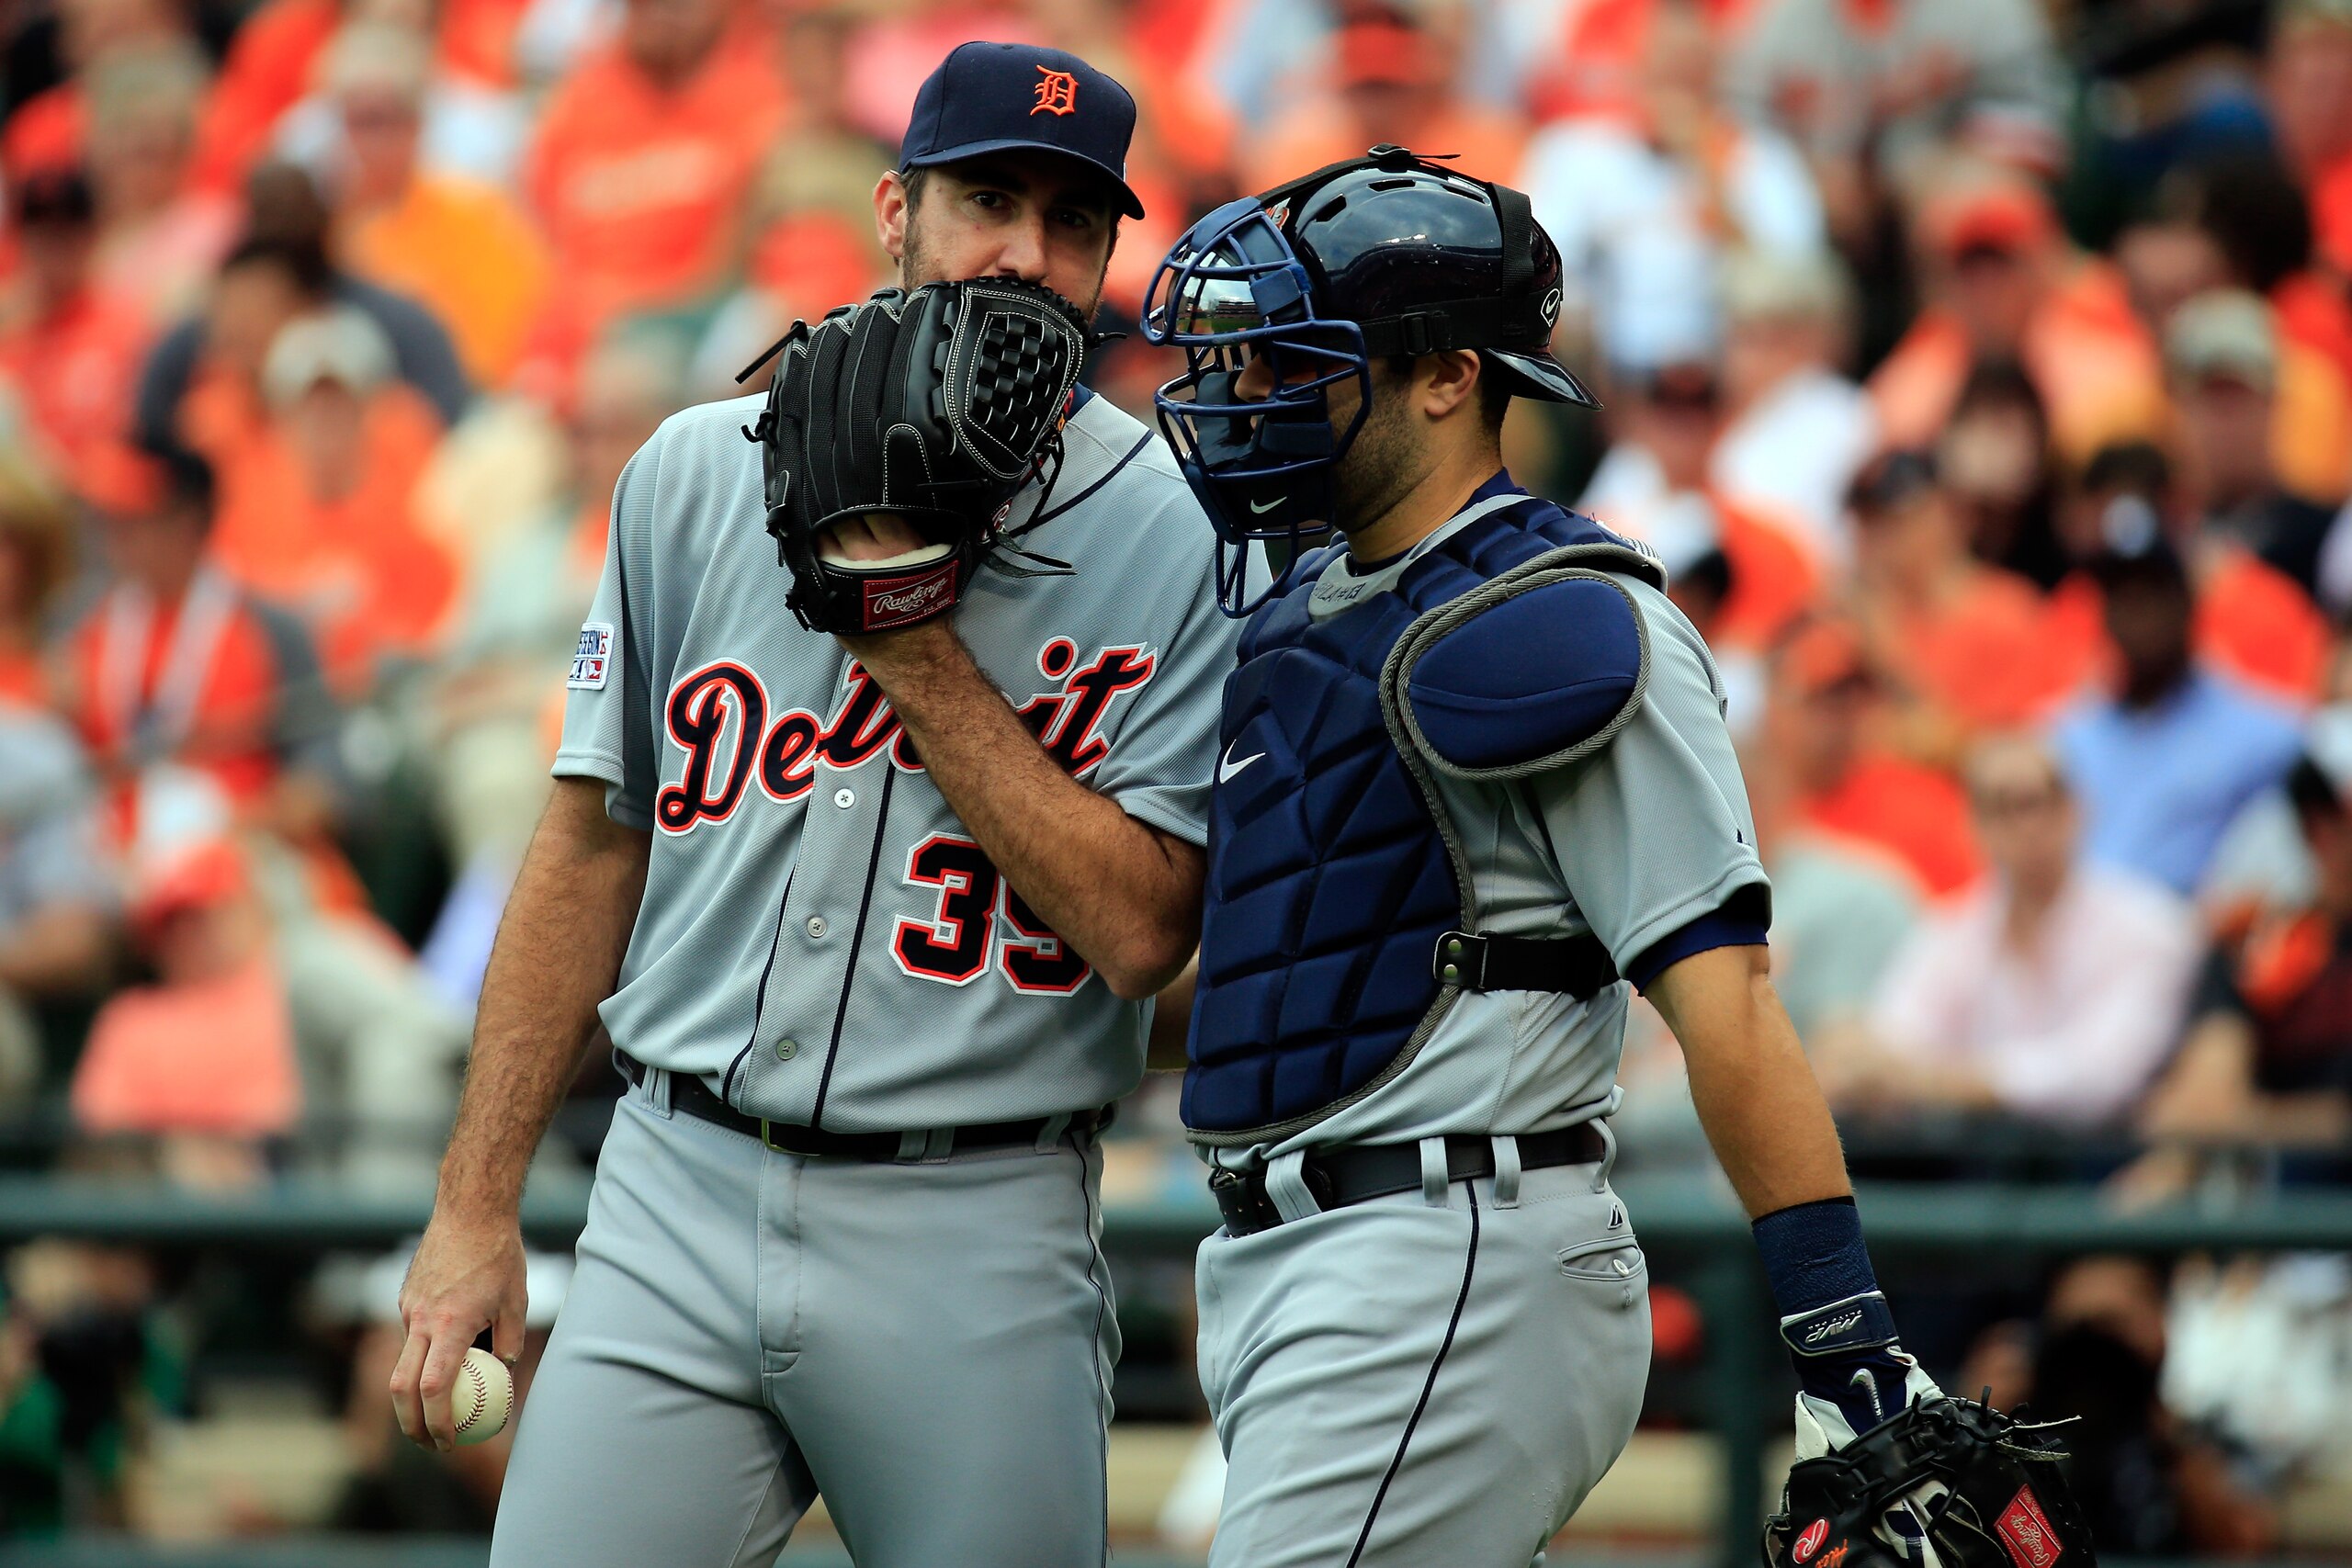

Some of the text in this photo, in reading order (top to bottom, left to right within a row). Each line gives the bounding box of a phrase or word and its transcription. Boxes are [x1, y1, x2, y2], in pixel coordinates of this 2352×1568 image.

[1030, 63, 1080, 117] D
[873, 577, 949, 615] Rawlings
[655, 641, 1159, 837] Detit
